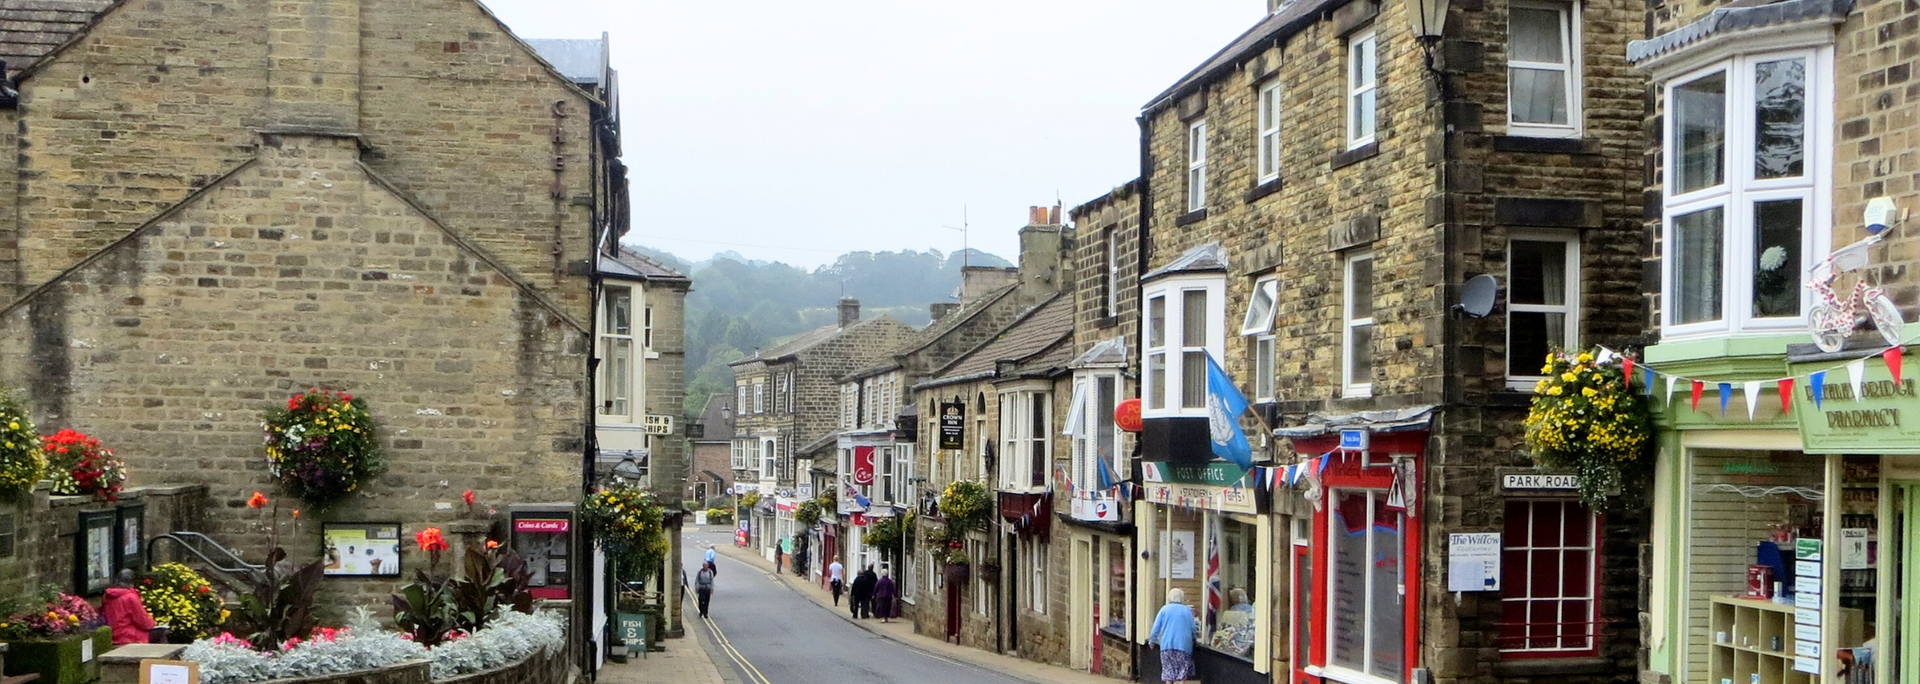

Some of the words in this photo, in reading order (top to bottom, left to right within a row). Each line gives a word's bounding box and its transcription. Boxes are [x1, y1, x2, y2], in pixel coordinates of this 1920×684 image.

[1805, 382, 1856, 401] PTELE
[1861, 378, 1915, 398] BRIDGE
[1826, 409, 1900, 427] PHARMACY
[645, 425, 667, 433] HIPS
[1176, 467, 1193, 479] POST
[1197, 467, 1224, 480] OFFICE
[1509, 476, 1541, 487] PARK
[1546, 476, 1578, 487] ROAD
[1450, 535, 1467, 545] The
[1467, 535, 1499, 545] Willow
[627, 628, 638, 638] &
